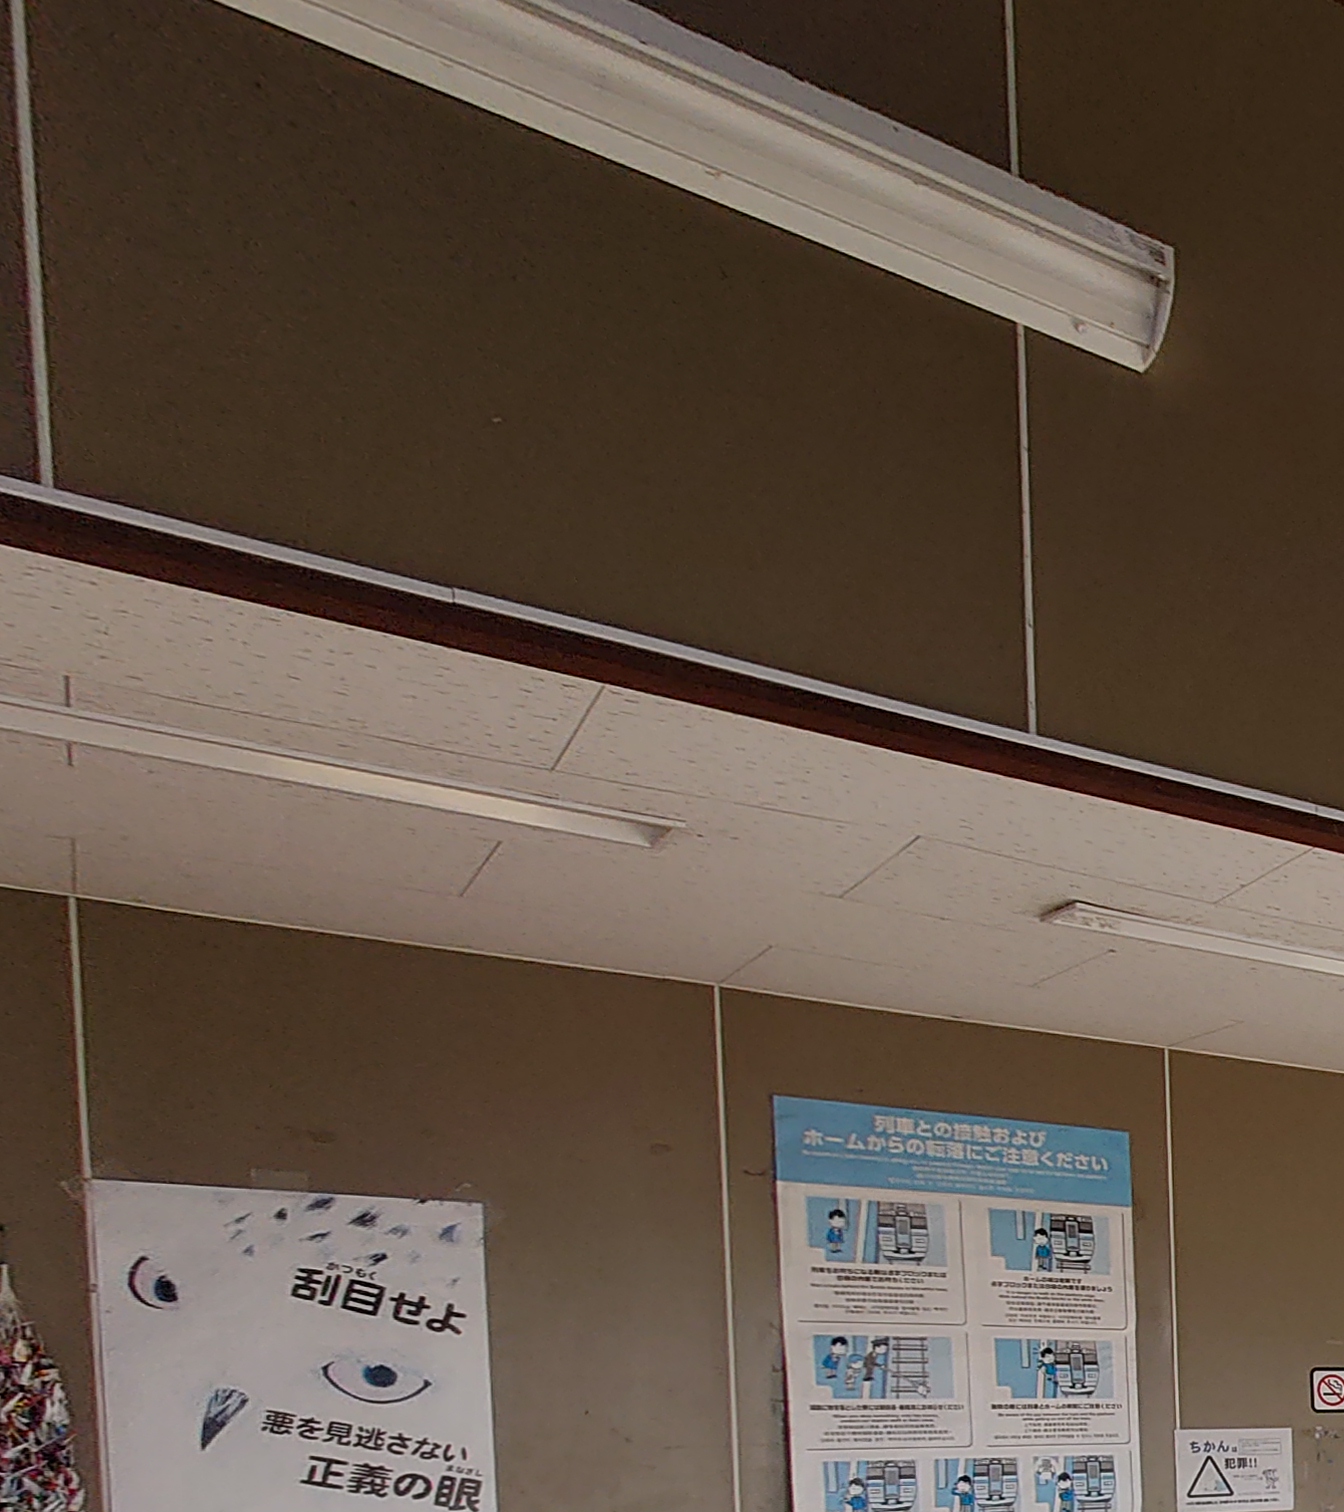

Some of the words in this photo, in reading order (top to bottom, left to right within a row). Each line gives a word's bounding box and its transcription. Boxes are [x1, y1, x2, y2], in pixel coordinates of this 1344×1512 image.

[803, 1129, 1109, 1172] ホームからの転落にご注意ください
[872, 1115, 1047, 1148] 列車との接触および
[291, 1267, 467, 1335] 刮目せよ
[261, 1410, 468, 1461] 悪を見逃さない
[300, 1455, 482, 1512] 正義の眼
[1224, 1458, 1258, 1469] 犯罪!!
